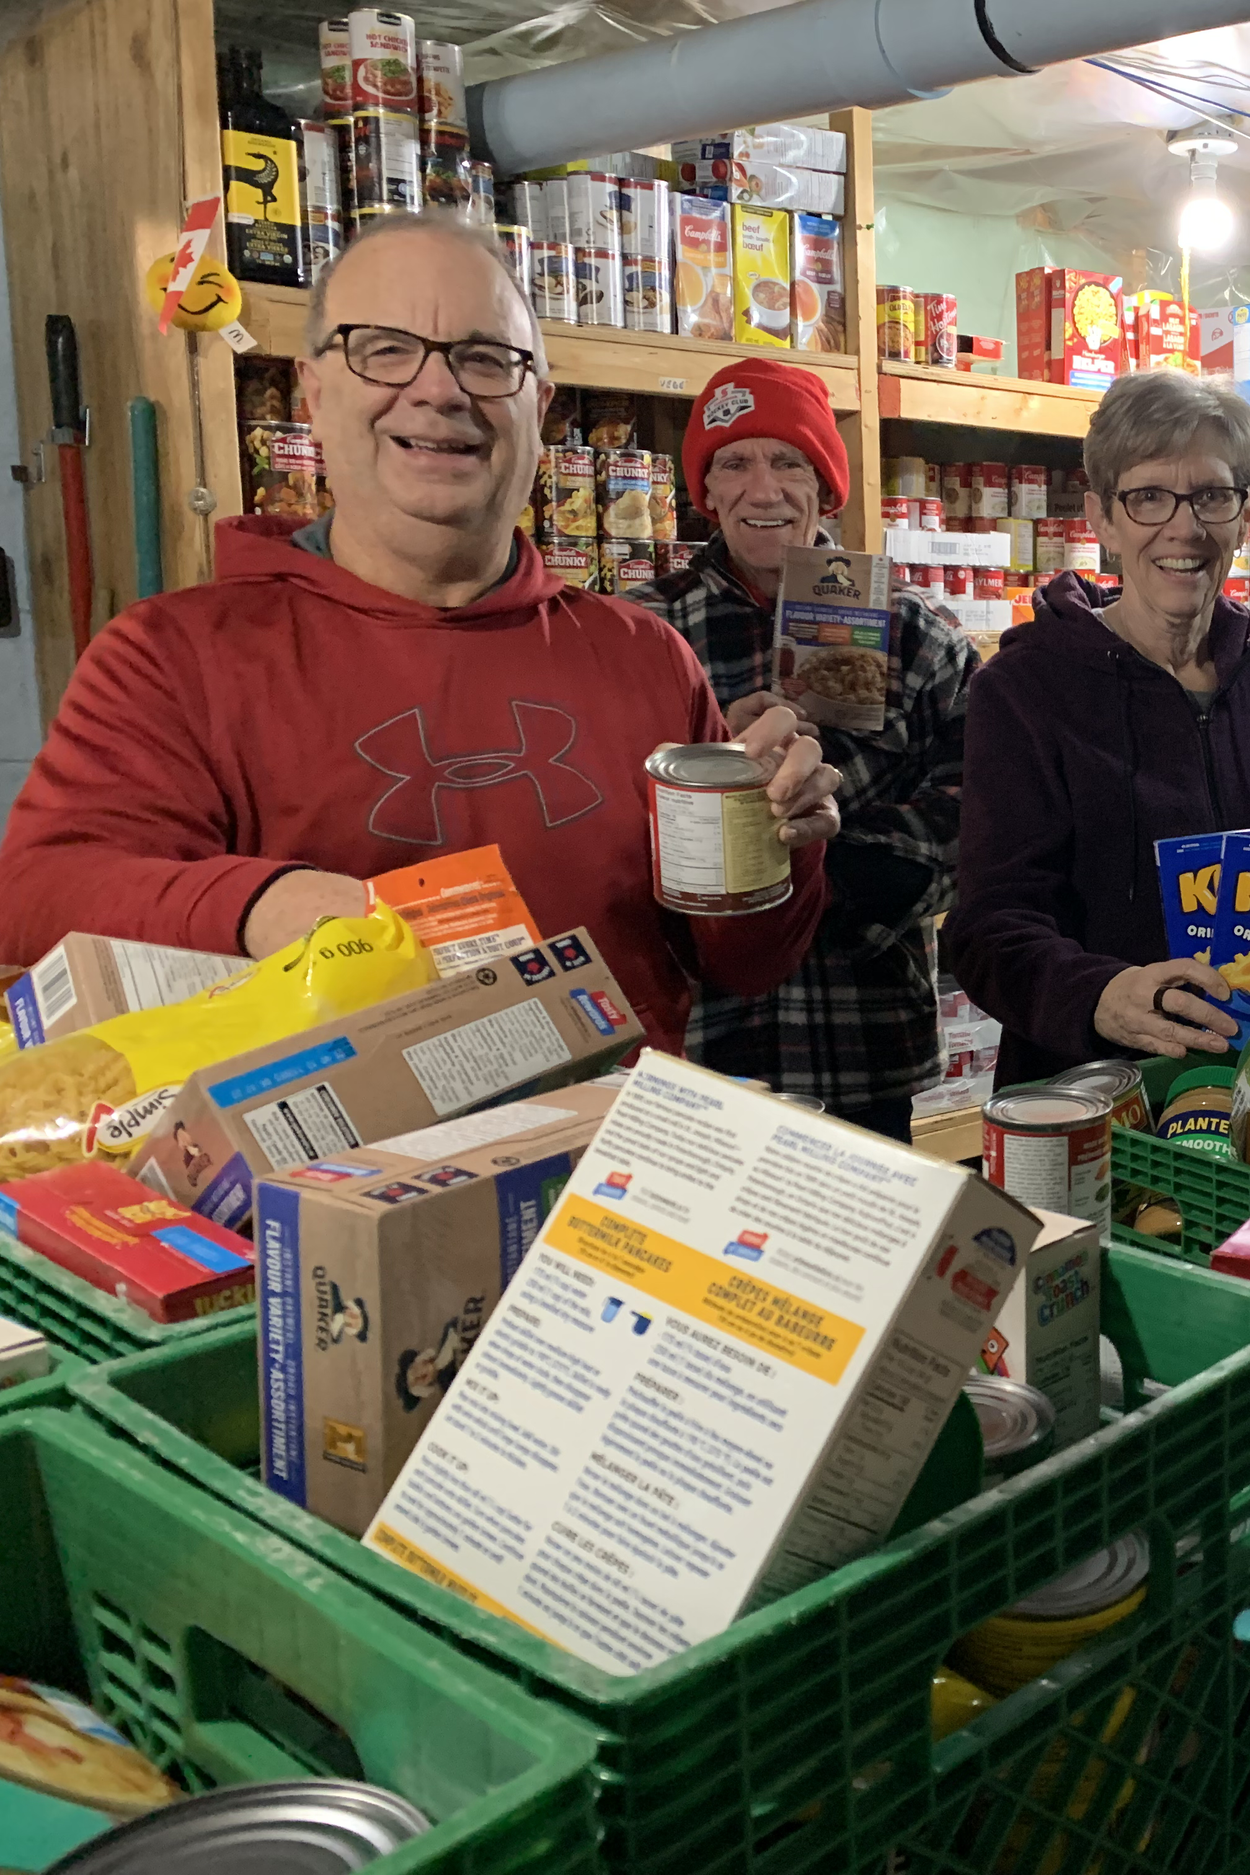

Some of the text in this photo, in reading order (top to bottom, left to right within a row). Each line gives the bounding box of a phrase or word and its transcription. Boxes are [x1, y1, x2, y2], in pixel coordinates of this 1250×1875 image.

[684, 225, 722, 242] Campbell's
[742, 222, 760, 234] beef
[1072, 356, 1115, 374] HELPER
[707, 398, 749, 420] HOCKEY CLUB
[608, 465, 649, 478] CHUNKY
[1069, 530, 1096, 539] Campbell's
[545, 555, 587, 568] CHUNKY
[812, 584, 862, 600] QUAKER
[336, 939, 374, 958] 900
[577, 994, 608, 1033] Rewards
[597, 995, 622, 1021] Tasty
[108, 1087, 178, 1140] Simple
[601, 1215, 648, 1246] COMPLETE
[264, 1218, 283, 1289] FLAVOUR
[621, 1242, 673, 1274] PANCAKES
[706, 1281, 758, 1315] COMPLET
[1043, 1271, 1081, 1299] Toast
[312, 1264, 329, 1352] QUAKER
[727, 1274, 825, 1327] CRÊPES MÉLANGE
[1037, 1278, 1091, 1327] Crunch
[665, 1315, 689, 1337] VOUS
